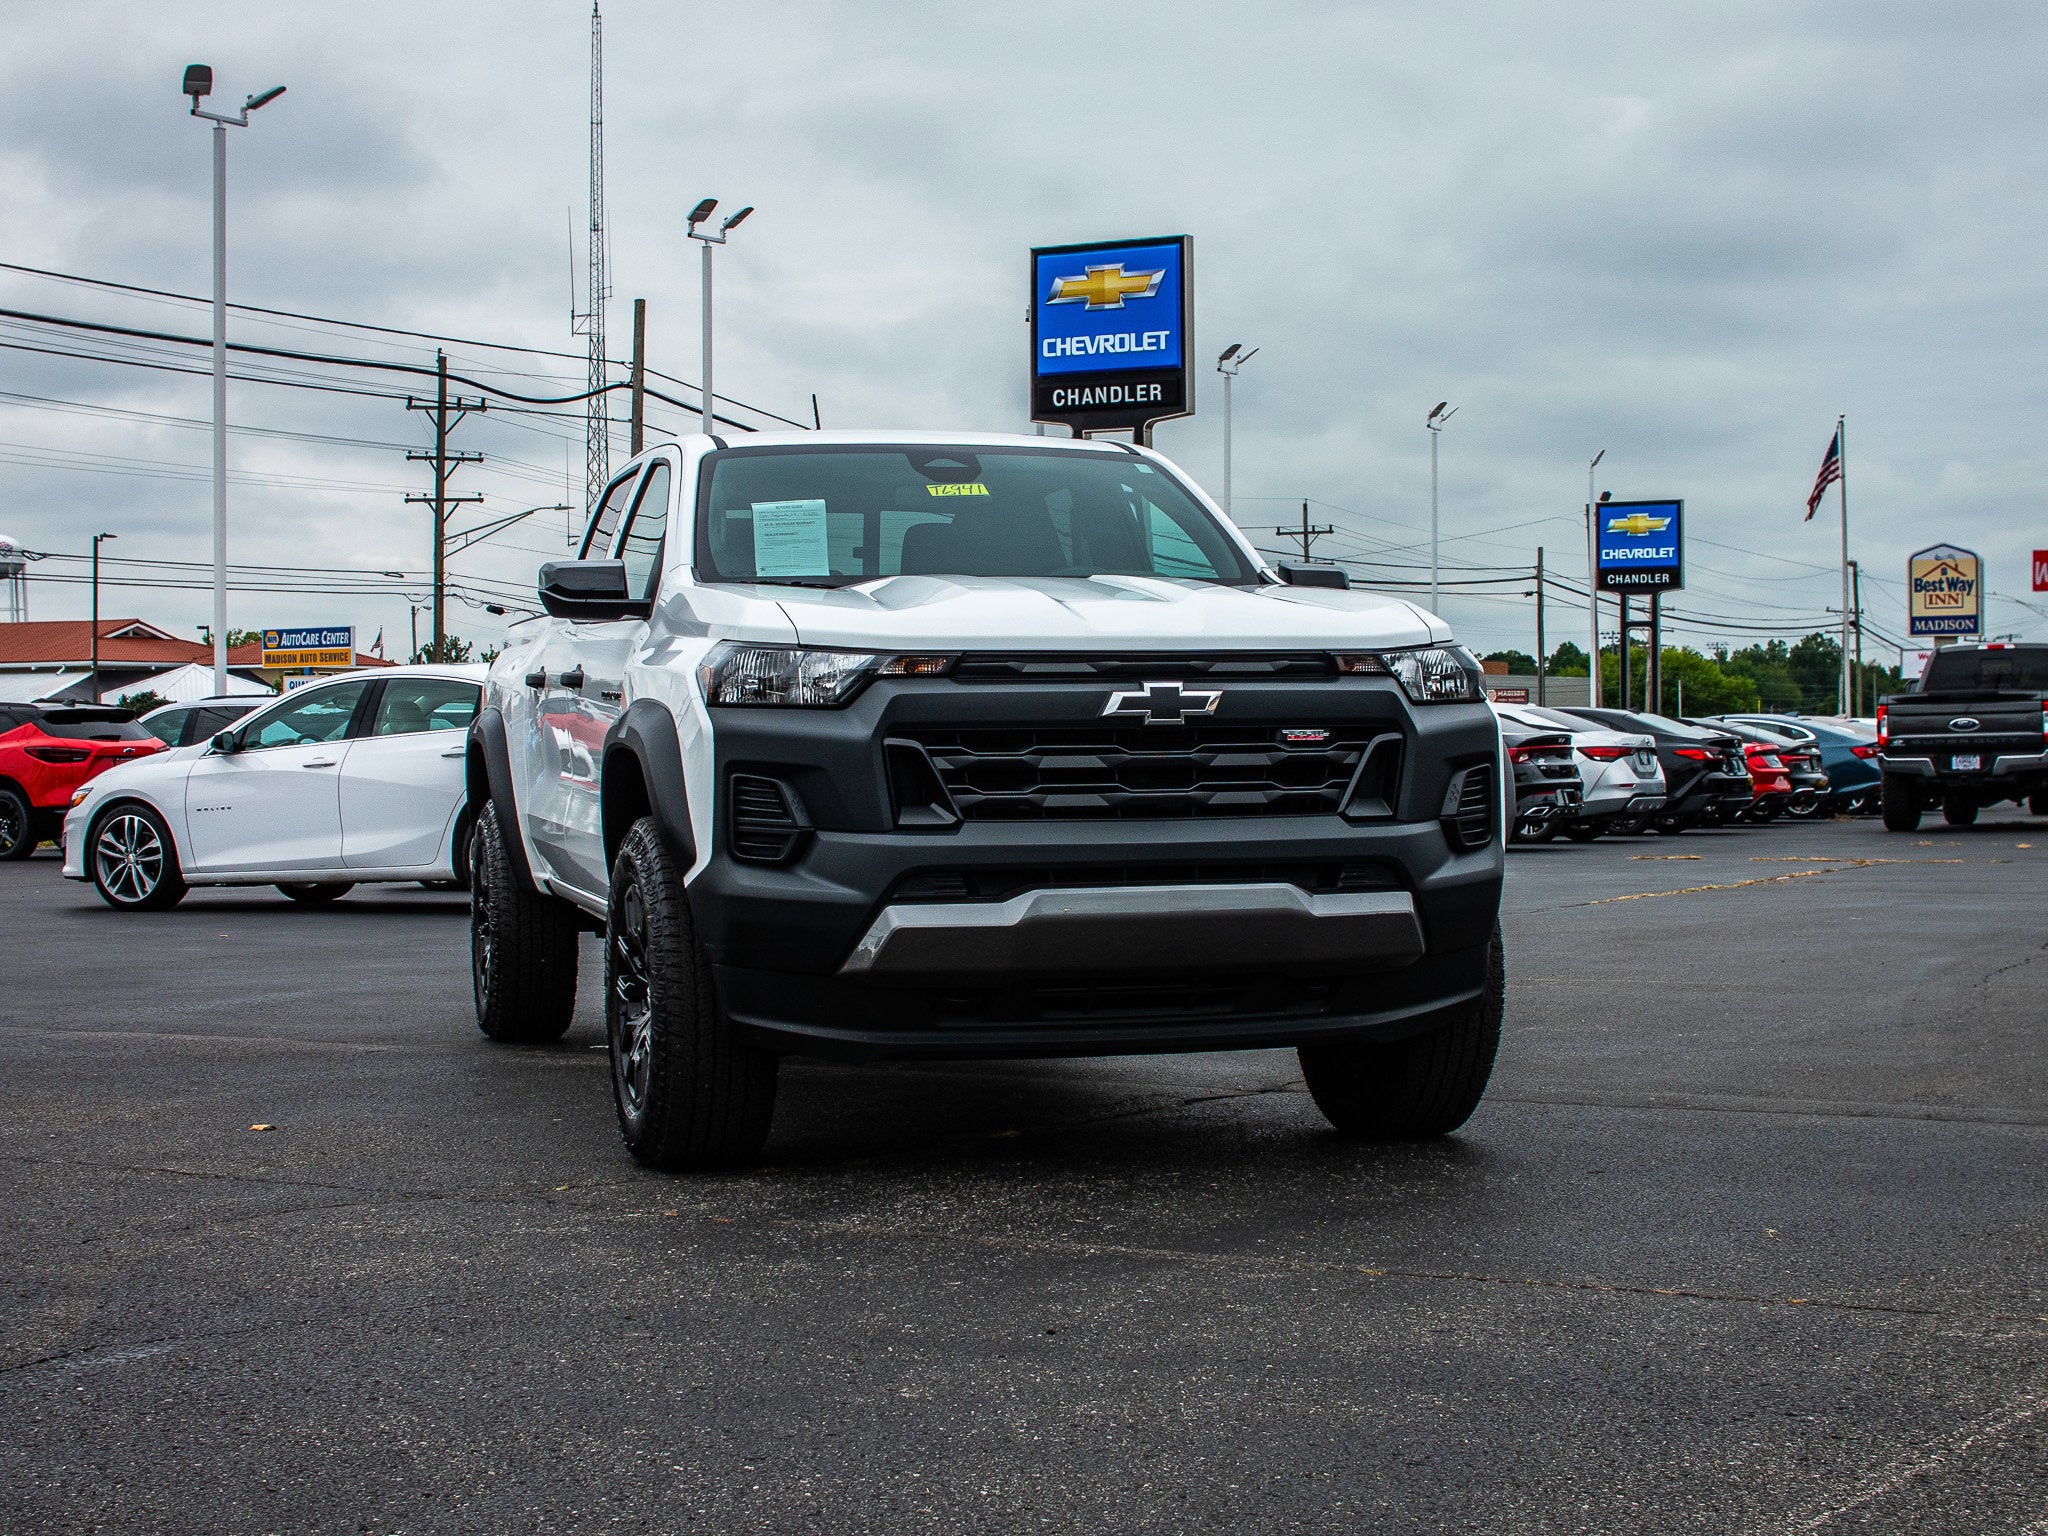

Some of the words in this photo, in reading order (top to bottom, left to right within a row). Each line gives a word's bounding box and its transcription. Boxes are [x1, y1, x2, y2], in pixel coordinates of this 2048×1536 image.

[1042, 330, 1170, 357] CHEVROLET
[1052, 384, 1162, 407] CHANDLER
[1602, 547, 1675, 560] CHEVROLET
[1607, 573, 1670, 584] CHANDLER
[1914, 577, 1945, 593] Best
[1945, 576, 1974, 596] Way
[1928, 593, 1959, 605] INN
[1914, 619, 1975, 631] MADISON
